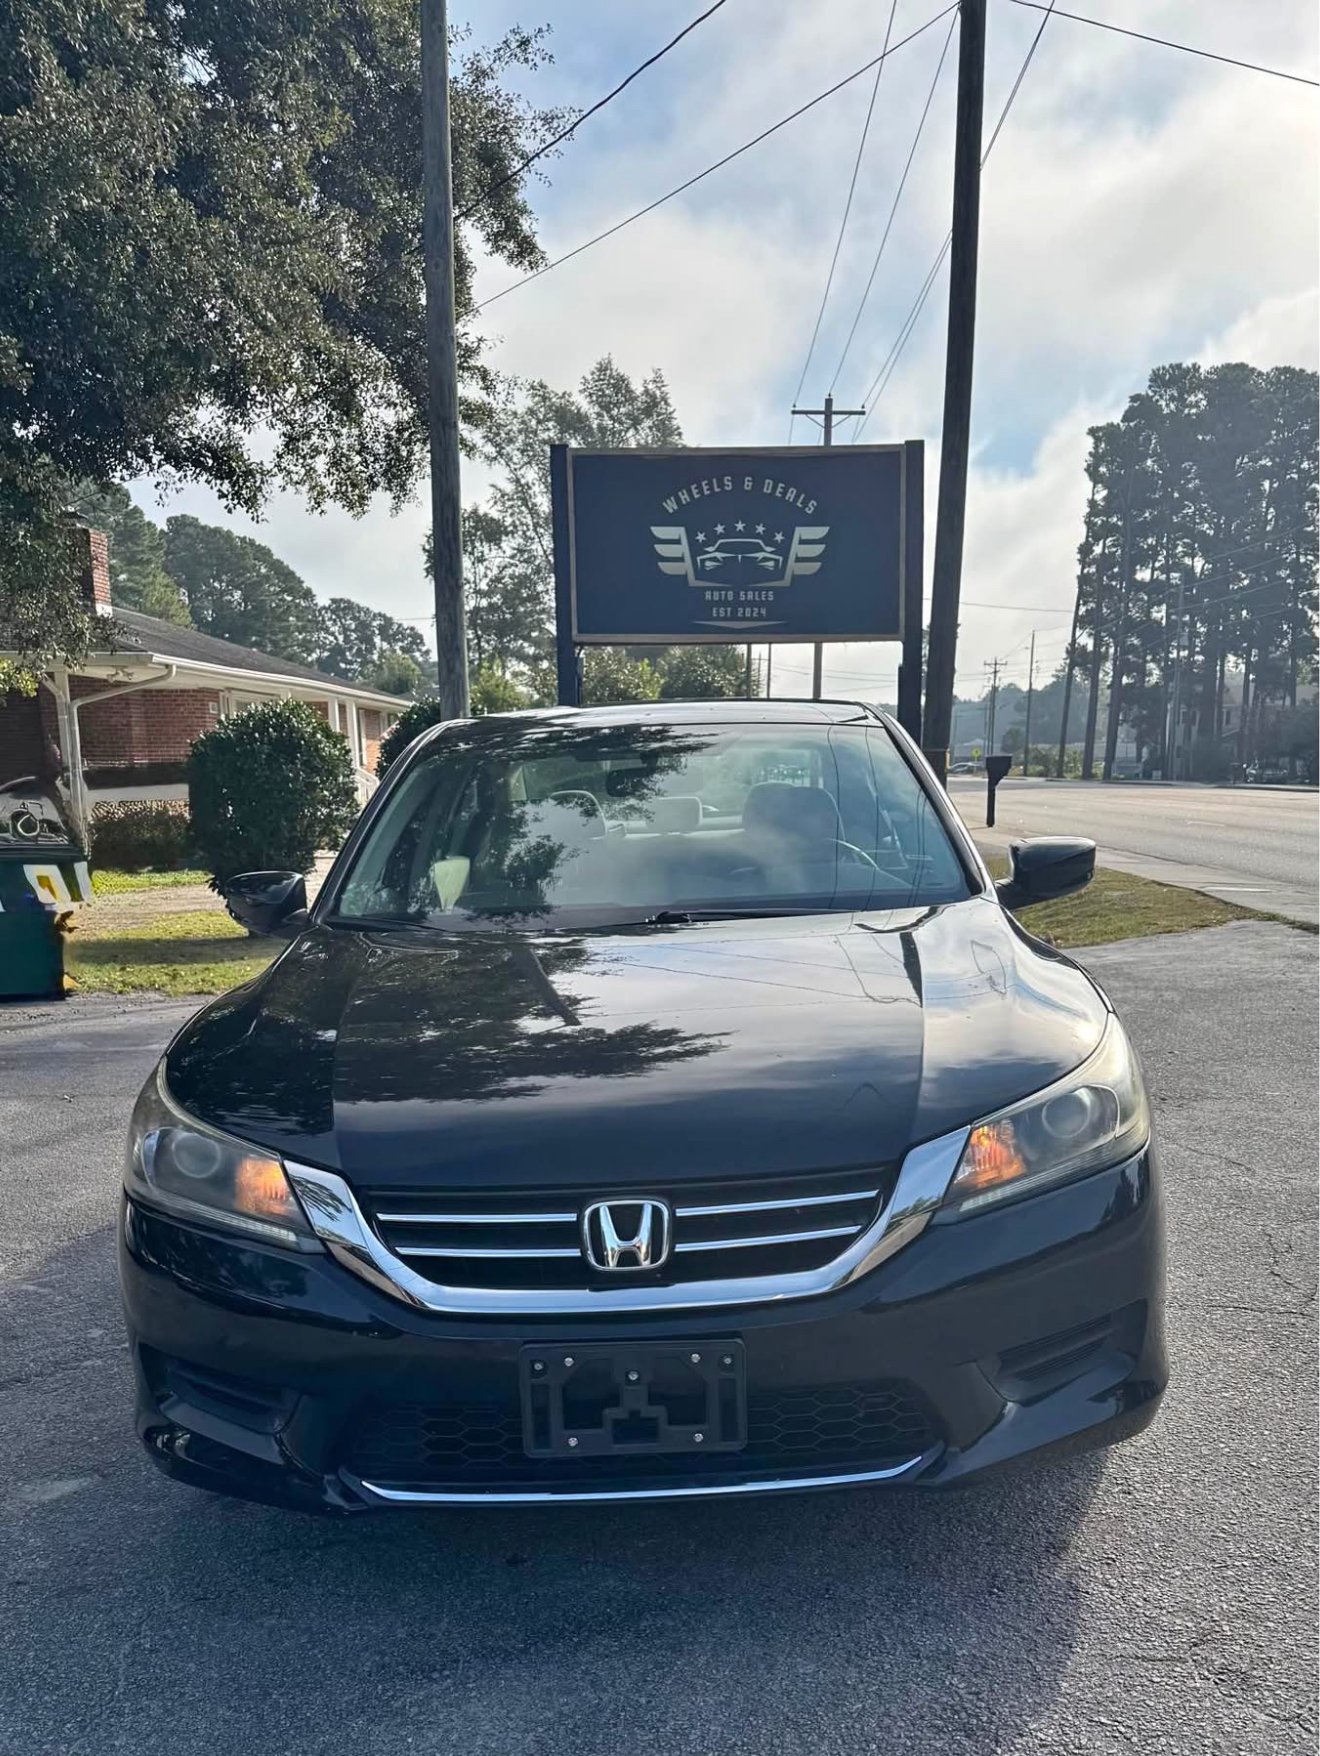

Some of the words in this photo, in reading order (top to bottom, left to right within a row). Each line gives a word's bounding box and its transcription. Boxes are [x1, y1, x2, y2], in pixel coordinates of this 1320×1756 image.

[662, 476, 733, 514] WHEELS
[744, 476, 753, 490] &
[763, 479, 817, 514] DEALS
[705, 590, 734, 601] AUTO
[739, 590, 774, 601] SALES
[712, 607, 732, 617] EST
[737, 607, 767, 617] 2024
